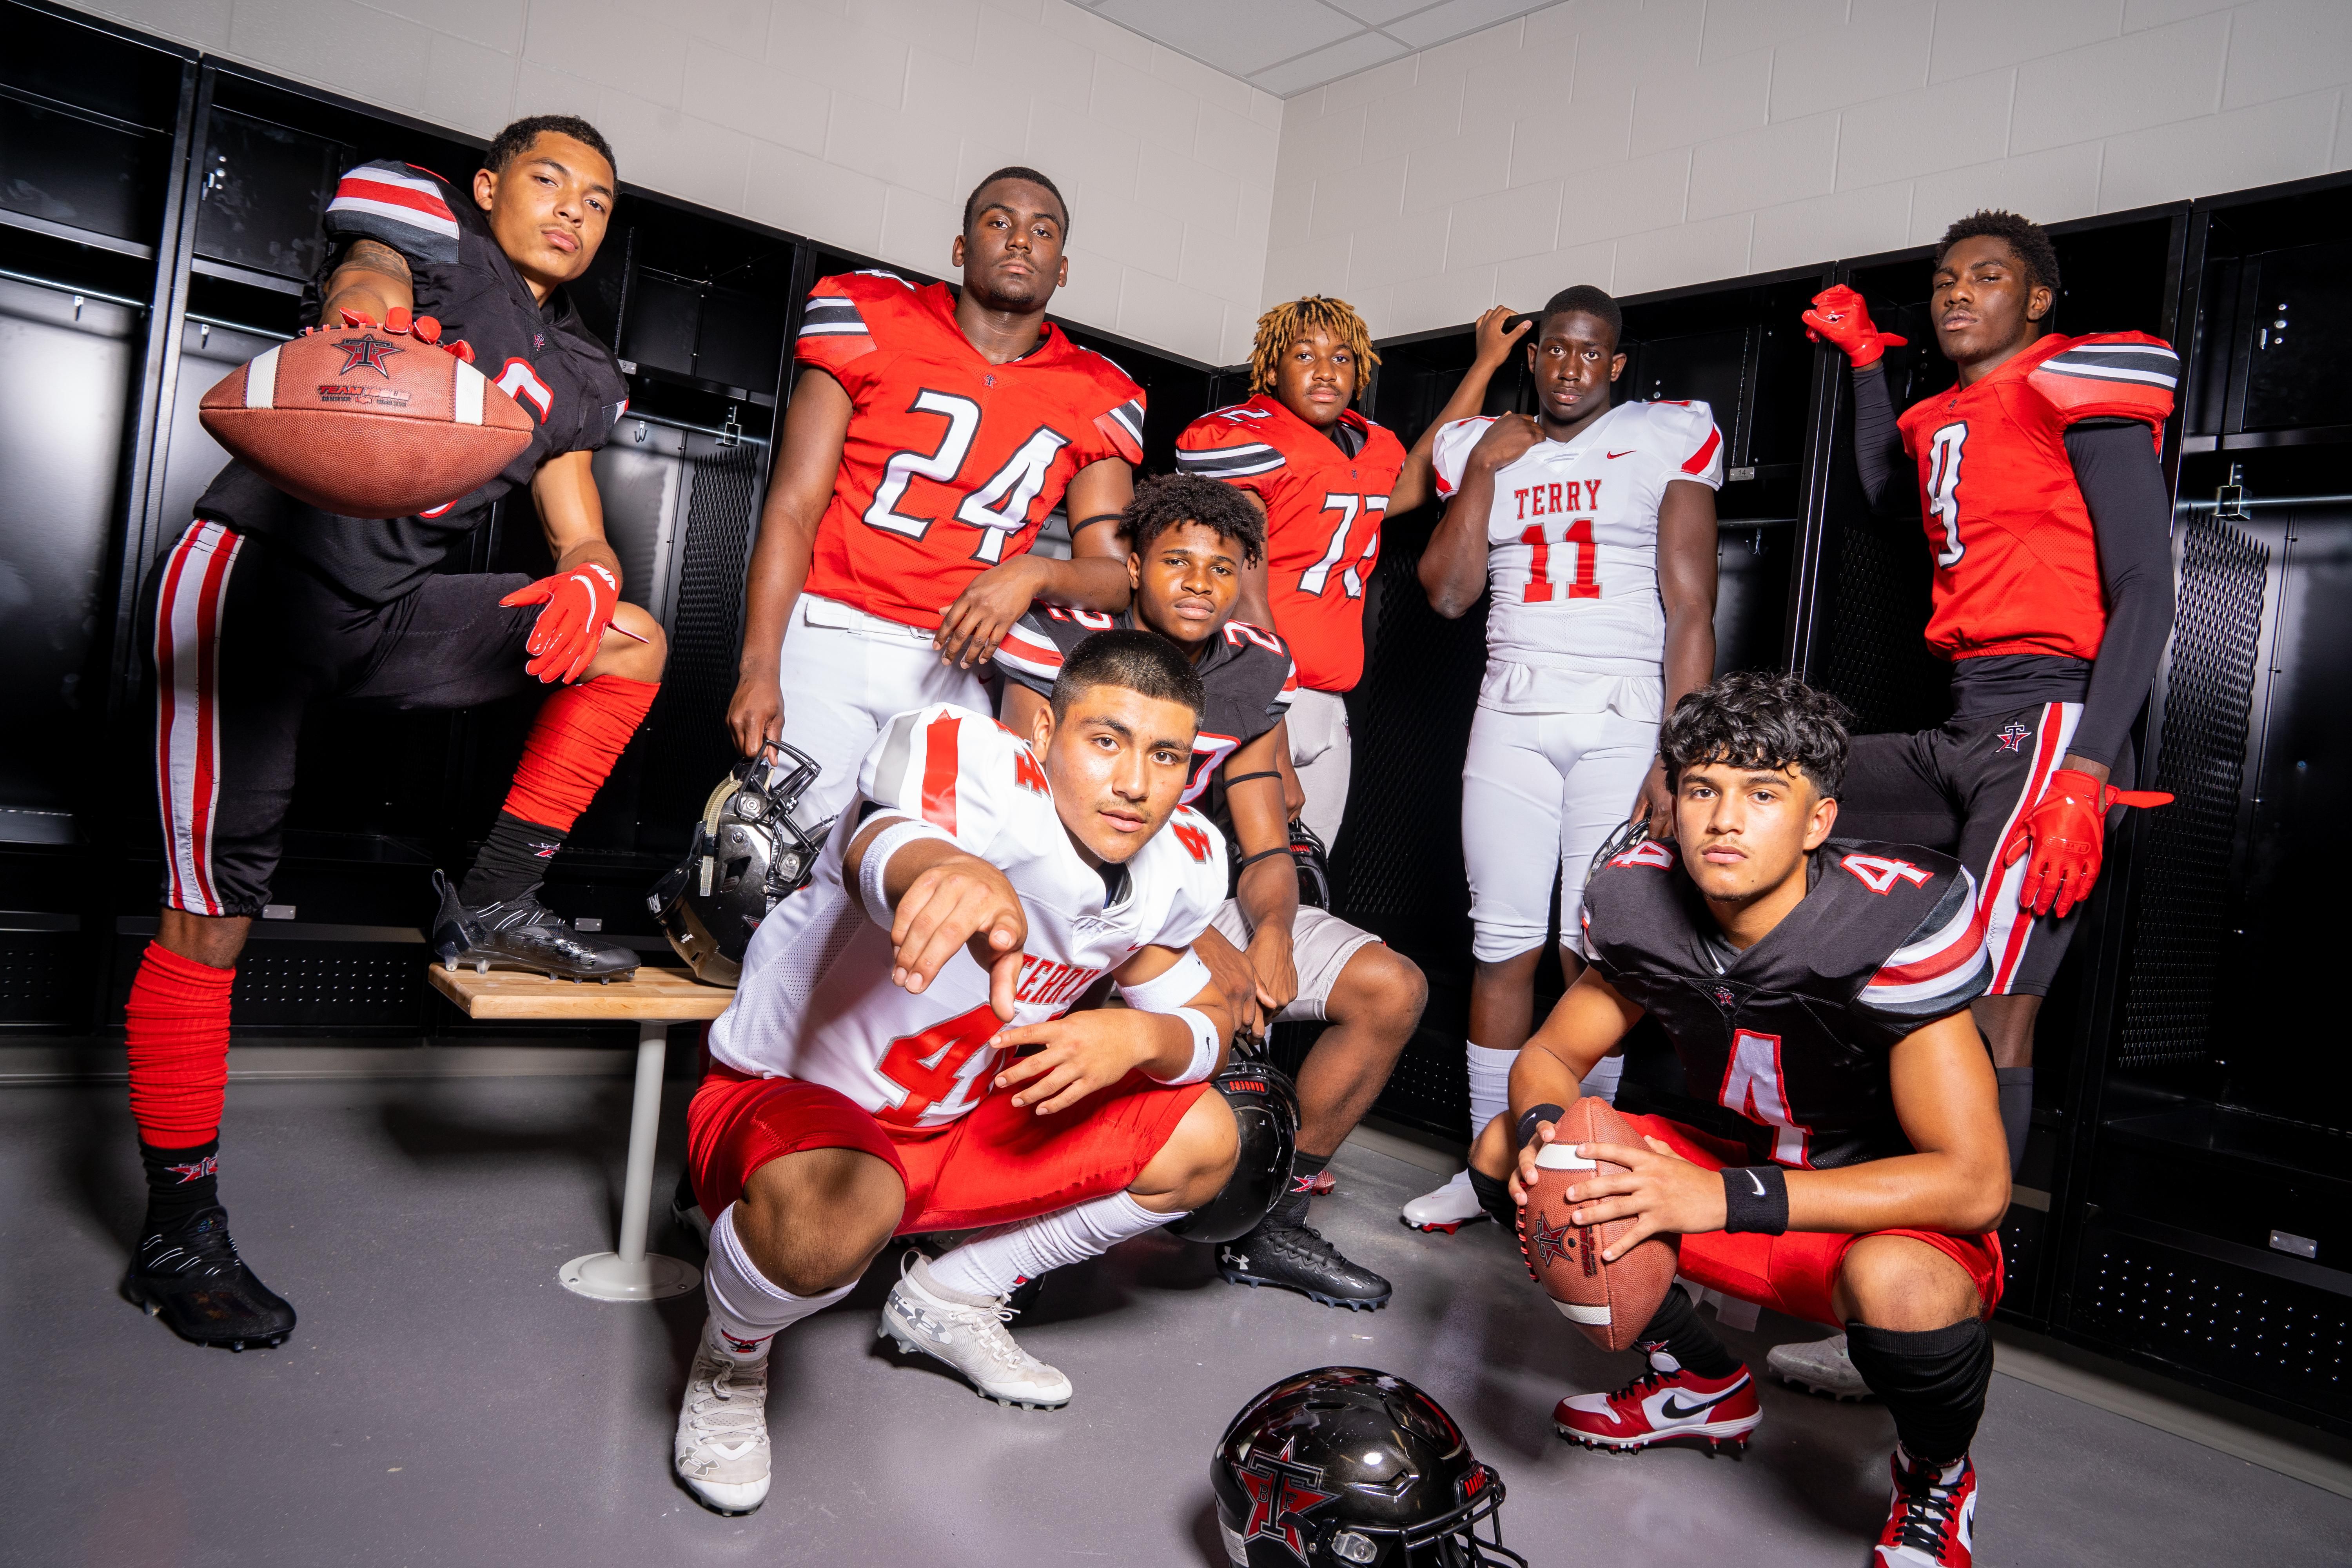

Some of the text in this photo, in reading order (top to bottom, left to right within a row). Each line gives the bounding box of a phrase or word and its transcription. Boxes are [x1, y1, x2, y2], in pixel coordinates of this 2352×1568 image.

[318, 386, 364, 395] TEAM
[862, 387, 1073, 565] 24
[1514, 479, 1602, 521] TERRY
[1926, 419, 1969, 571] 9
[1518, 517, 1603, 603] 11
[1840, 853, 1934, 896] 4
[1229, 1081, 1265, 1092] RANGERS
[1719, 1028, 1817, 1171] 4
[1249, 1453, 1320, 1539] B T F
